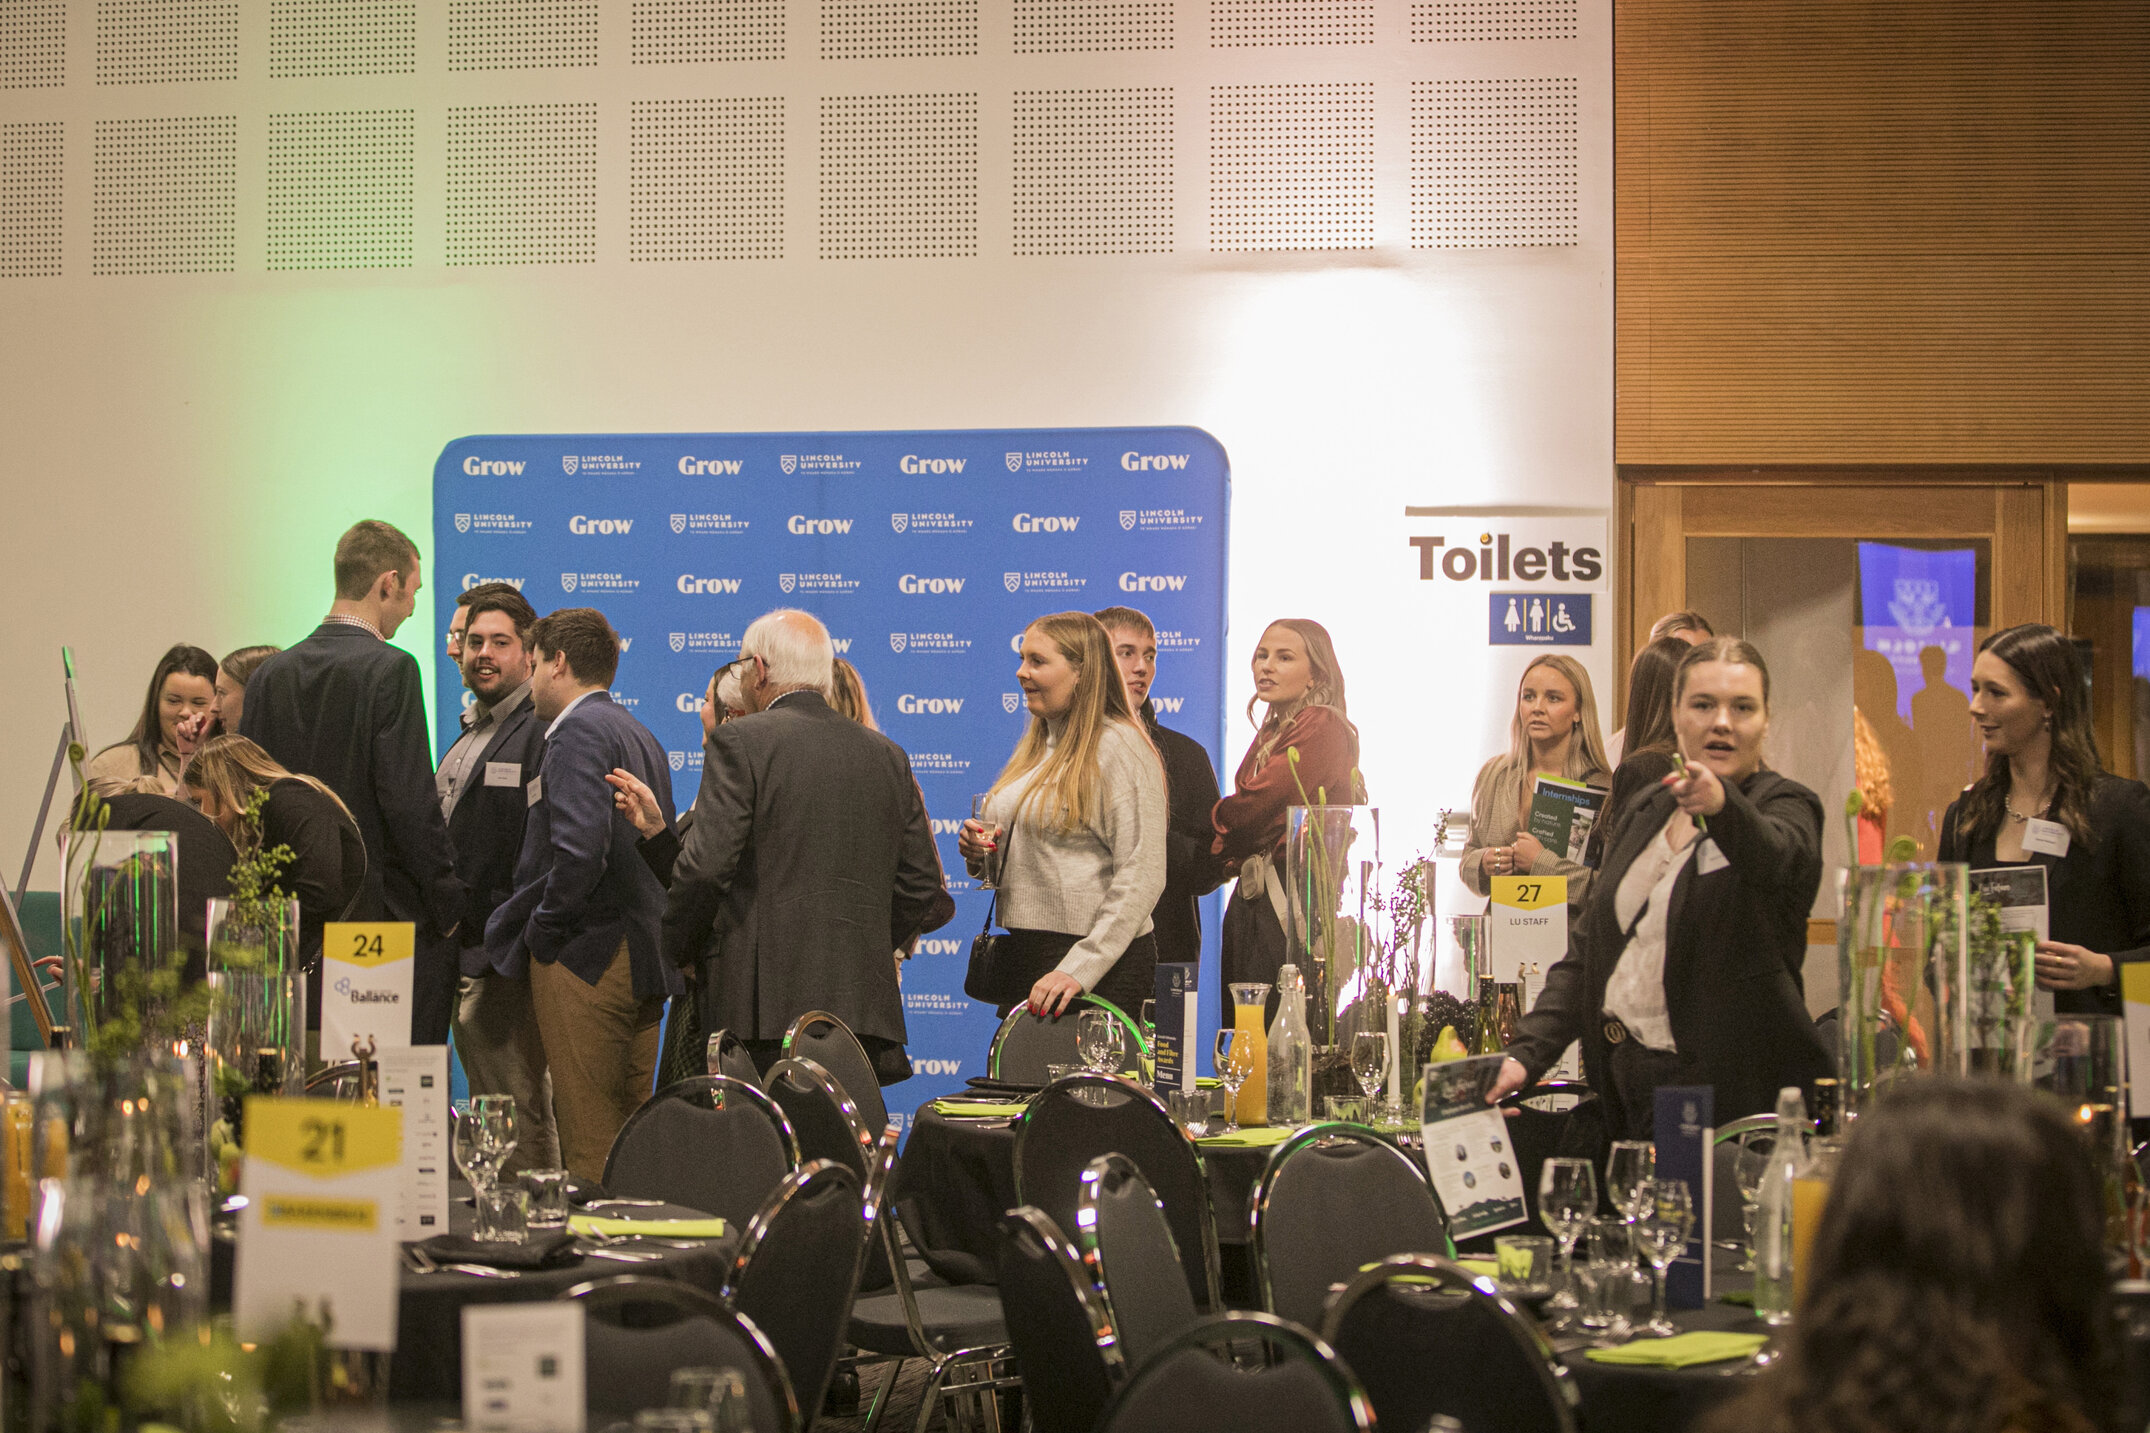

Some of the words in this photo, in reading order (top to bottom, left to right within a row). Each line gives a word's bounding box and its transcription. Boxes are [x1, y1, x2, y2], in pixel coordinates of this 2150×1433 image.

[800, 454, 843, 462] LINCOLN
[1026, 451, 1069, 459] LINCOLN
[1026, 458, 1088, 466] UNIVERSITY
[1121, 451, 1190, 471] Grow
[463, 456, 526, 475] Grow
[582, 462, 641, 470] UNIVERSITY
[678, 456, 743, 475] Grow
[800, 461, 861, 469] UNIVERSITY
[900, 455, 966, 474] Grow
[1139, 509, 1184, 518] LINCOLN
[1139, 516, 1203, 525] UNIVERSITY
[569, 515, 633, 534] Grow
[788, 515, 853, 534] Grow
[912, 520, 974, 528] UNIVERSITY
[1013, 513, 1080, 533] Grow
[1409, 532, 1602, 582] Toilets
[580, 580, 640, 588] UNIVERSITY
[677, 574, 742, 594] Grow
[799, 580, 860, 588] UNIVERSITY
[898, 574, 966, 594] Grow
[1024, 572, 1068, 580] LINCOLN
[1024, 578, 1087, 587] UNIVERSITY
[1118, 571, 1187, 592] Grow
[688, 632, 731, 640] LINCOLN
[1155, 631, 1182, 639] COLN
[1157, 638, 1201, 646] VERSITY
[910, 640, 972, 648] UNIVERSITY
[897, 694, 964, 714] Grow
[1151, 697, 1184, 713] ow
[1542, 788, 1590, 806] Internships
[931, 819, 963, 834] ow
[1516, 884, 1542, 902] 27
[1509, 918, 1520, 926] LU
[1523, 918, 1549, 926] STAFF
[353, 934, 384, 957] 24
[913, 939, 962, 956] row
[910, 1059, 962, 1075] row
[300, 1118, 345, 1162] 21
